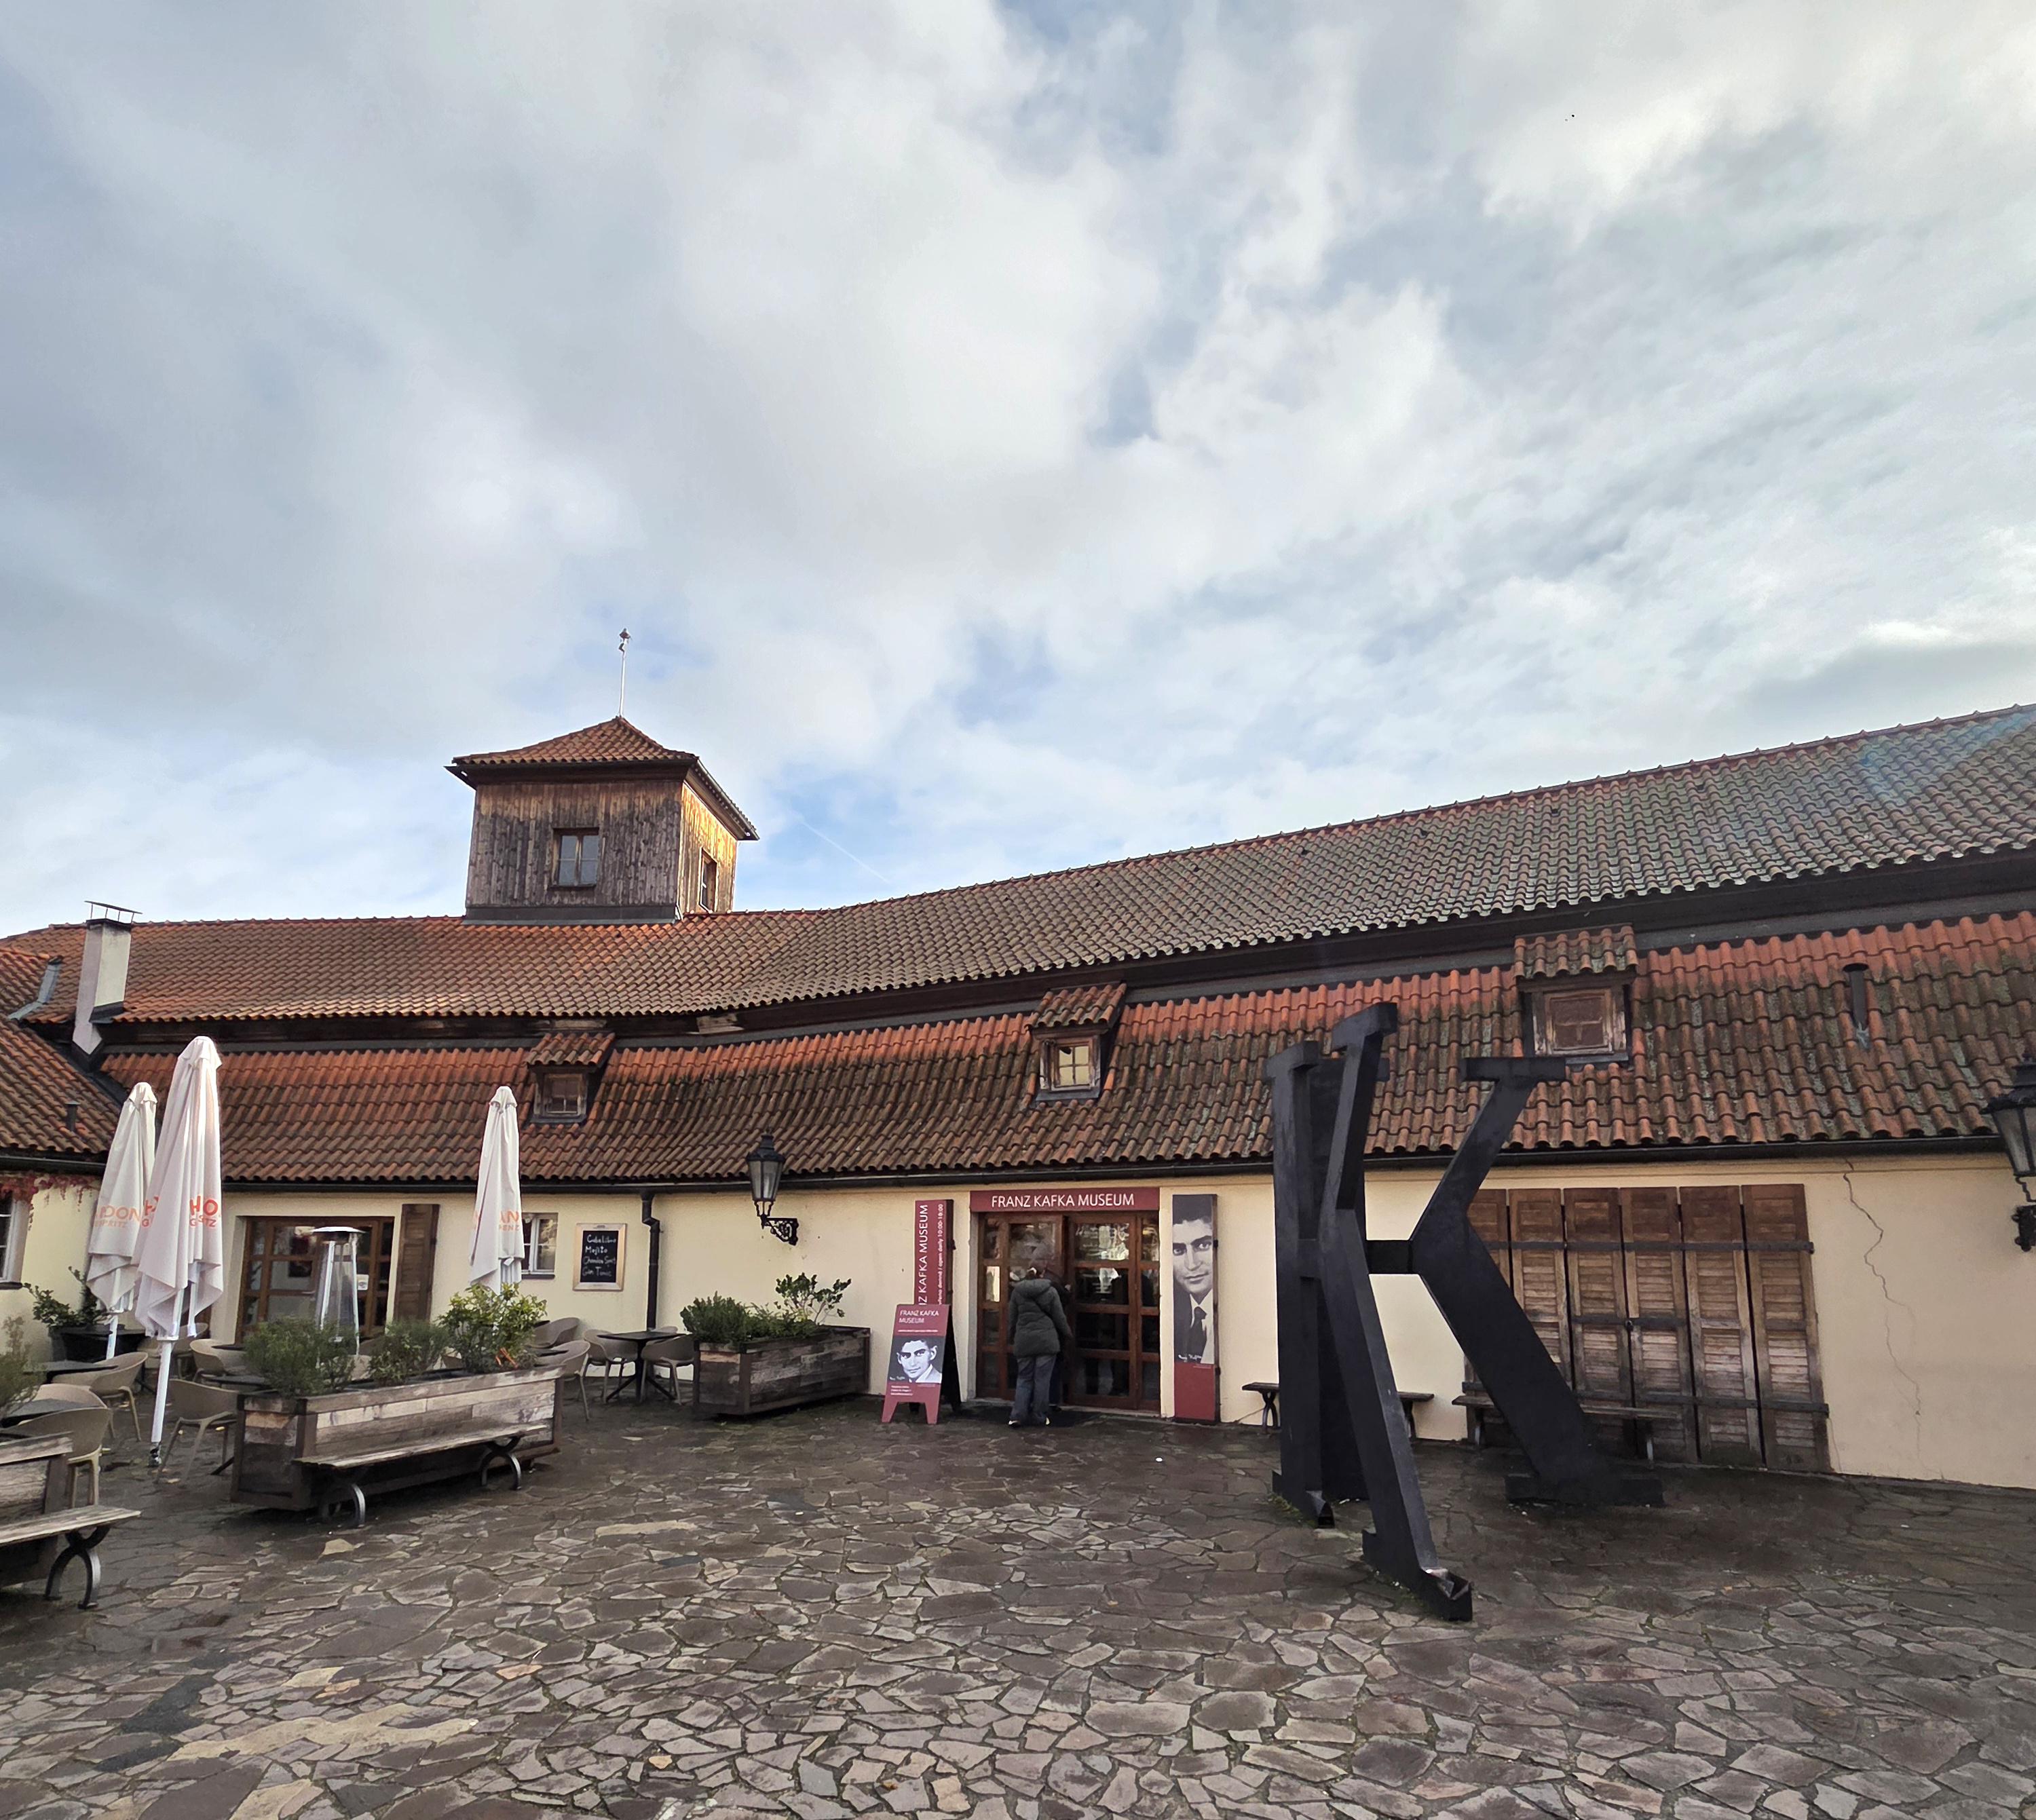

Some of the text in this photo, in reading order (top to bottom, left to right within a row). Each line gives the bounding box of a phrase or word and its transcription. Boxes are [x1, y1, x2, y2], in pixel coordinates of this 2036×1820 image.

[992, 1193, 1134, 1207] FRANZ KAFKA MUSEUM
[919, 1205, 928, 1253] MUSEUM
[918, 1255, 928, 1293] KAFKA
